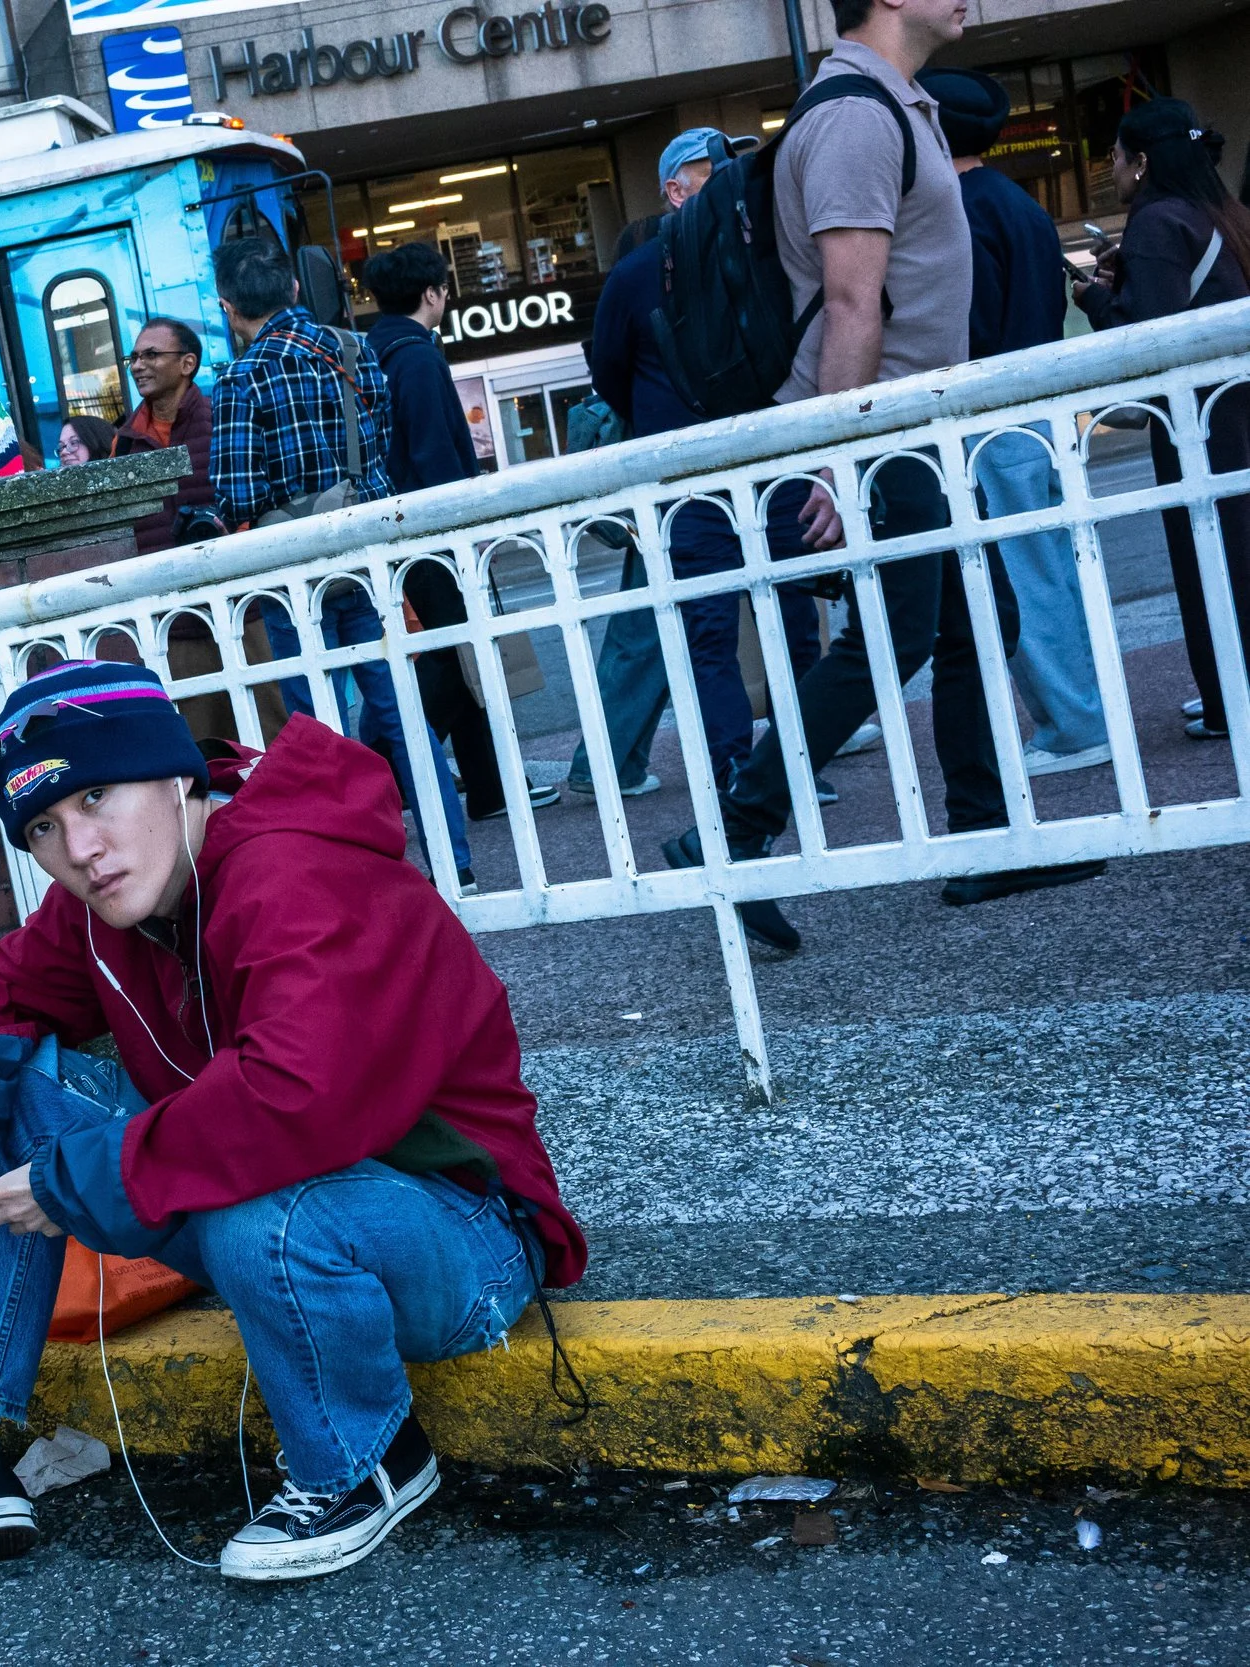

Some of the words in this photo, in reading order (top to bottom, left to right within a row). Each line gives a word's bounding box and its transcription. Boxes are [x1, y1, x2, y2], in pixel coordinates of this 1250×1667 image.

[207, 27, 425, 102] Harbour
[437, 0, 612, 64] Centre
[1010, 136, 1060, 152] PRINTING
